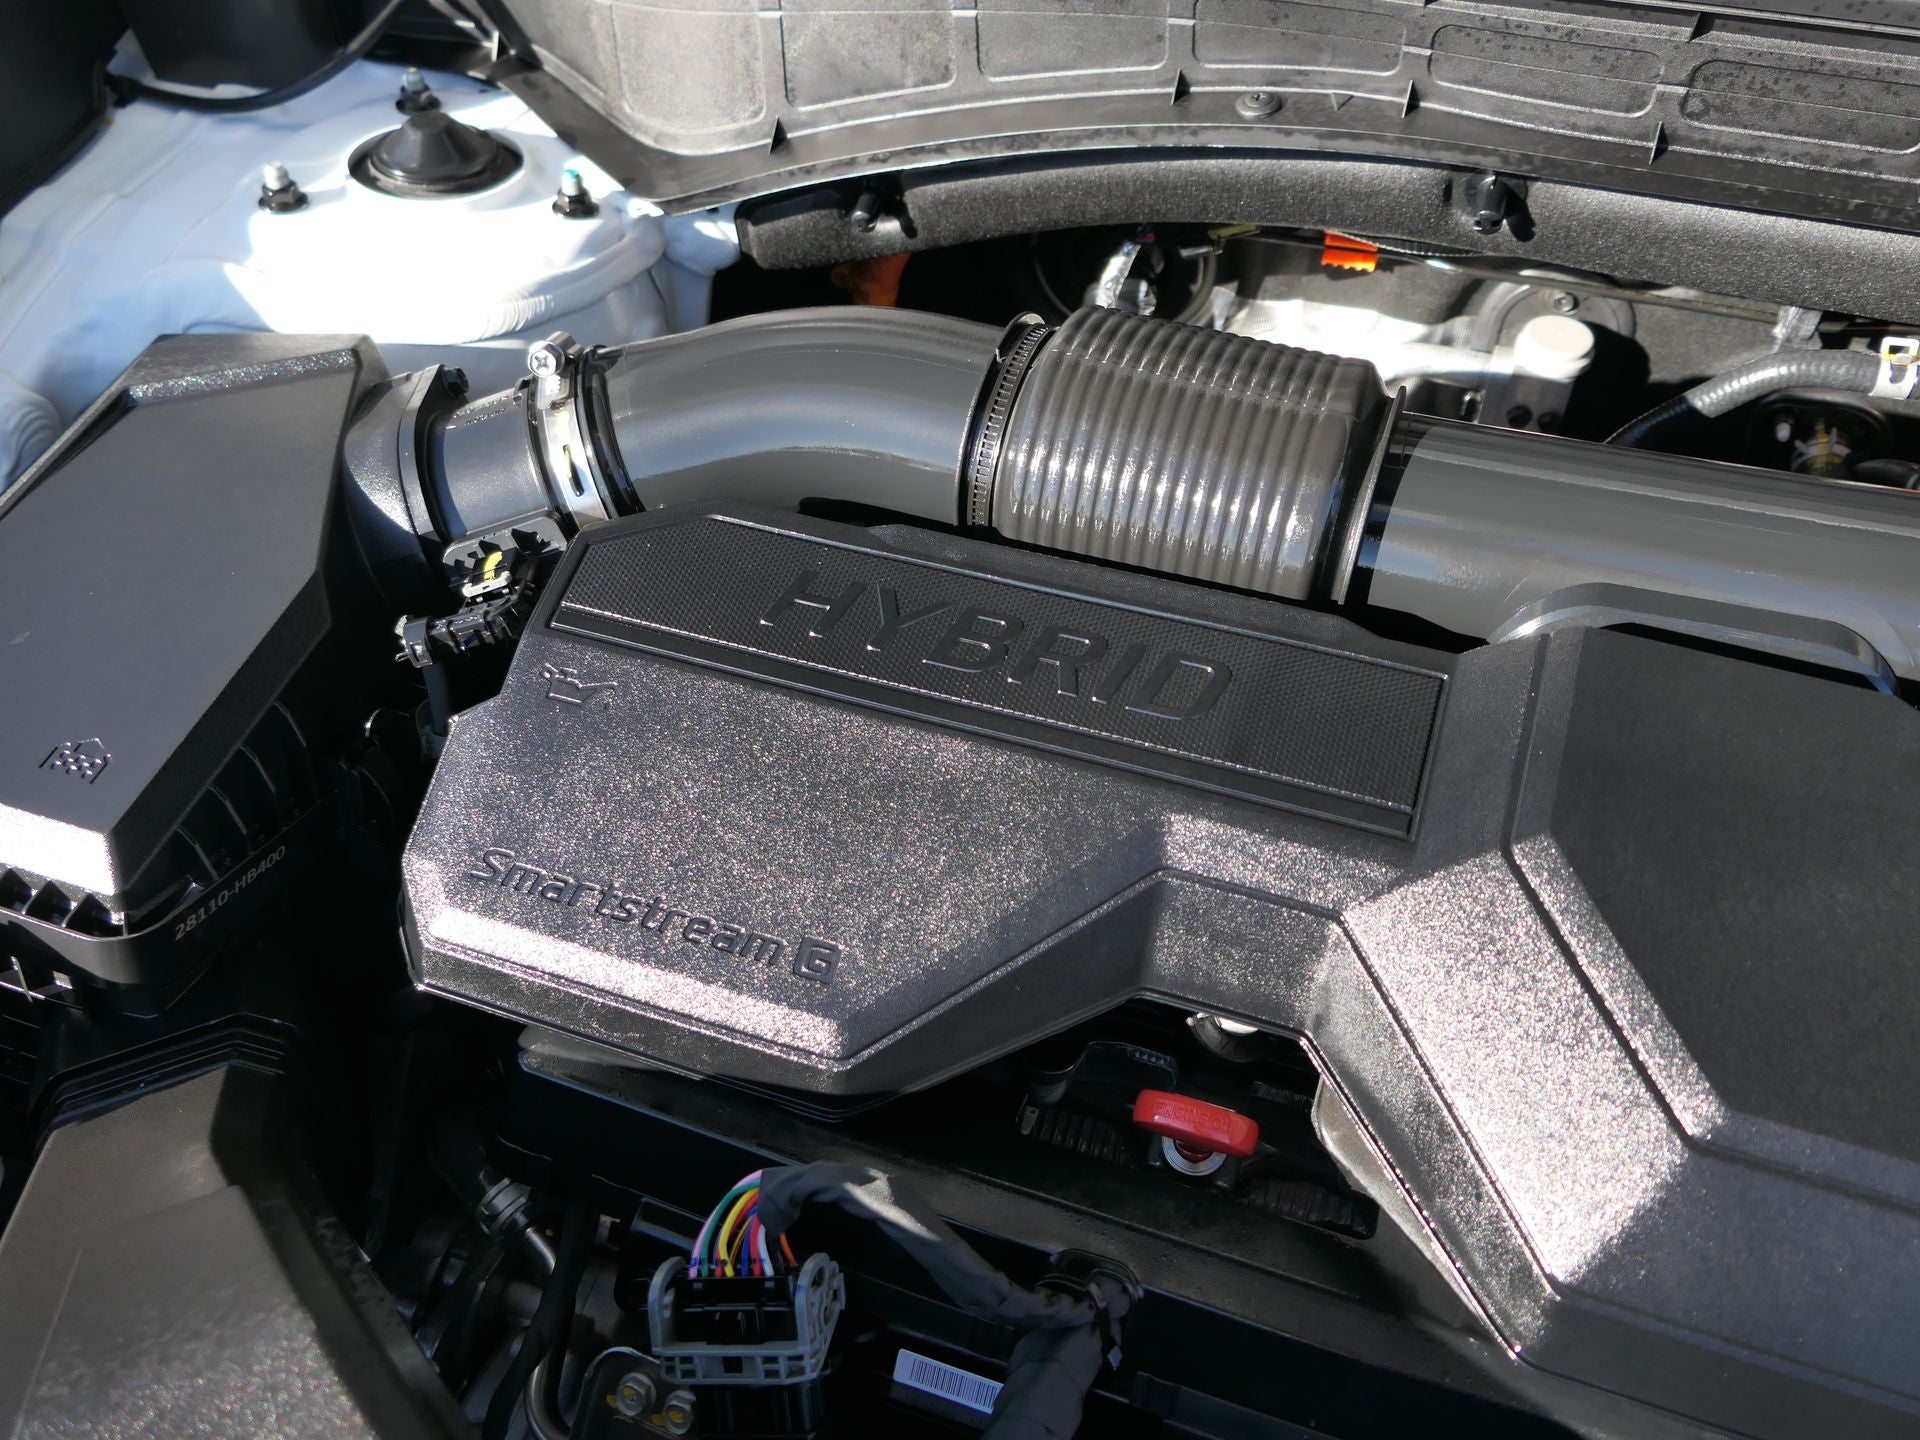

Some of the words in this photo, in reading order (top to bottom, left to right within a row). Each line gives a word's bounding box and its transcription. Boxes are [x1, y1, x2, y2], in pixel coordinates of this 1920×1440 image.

[758, 569, 1232, 721] HYBRID
[175, 845, 286, 941] 28110-HB400
[469, 847, 789, 966] Smartstream
